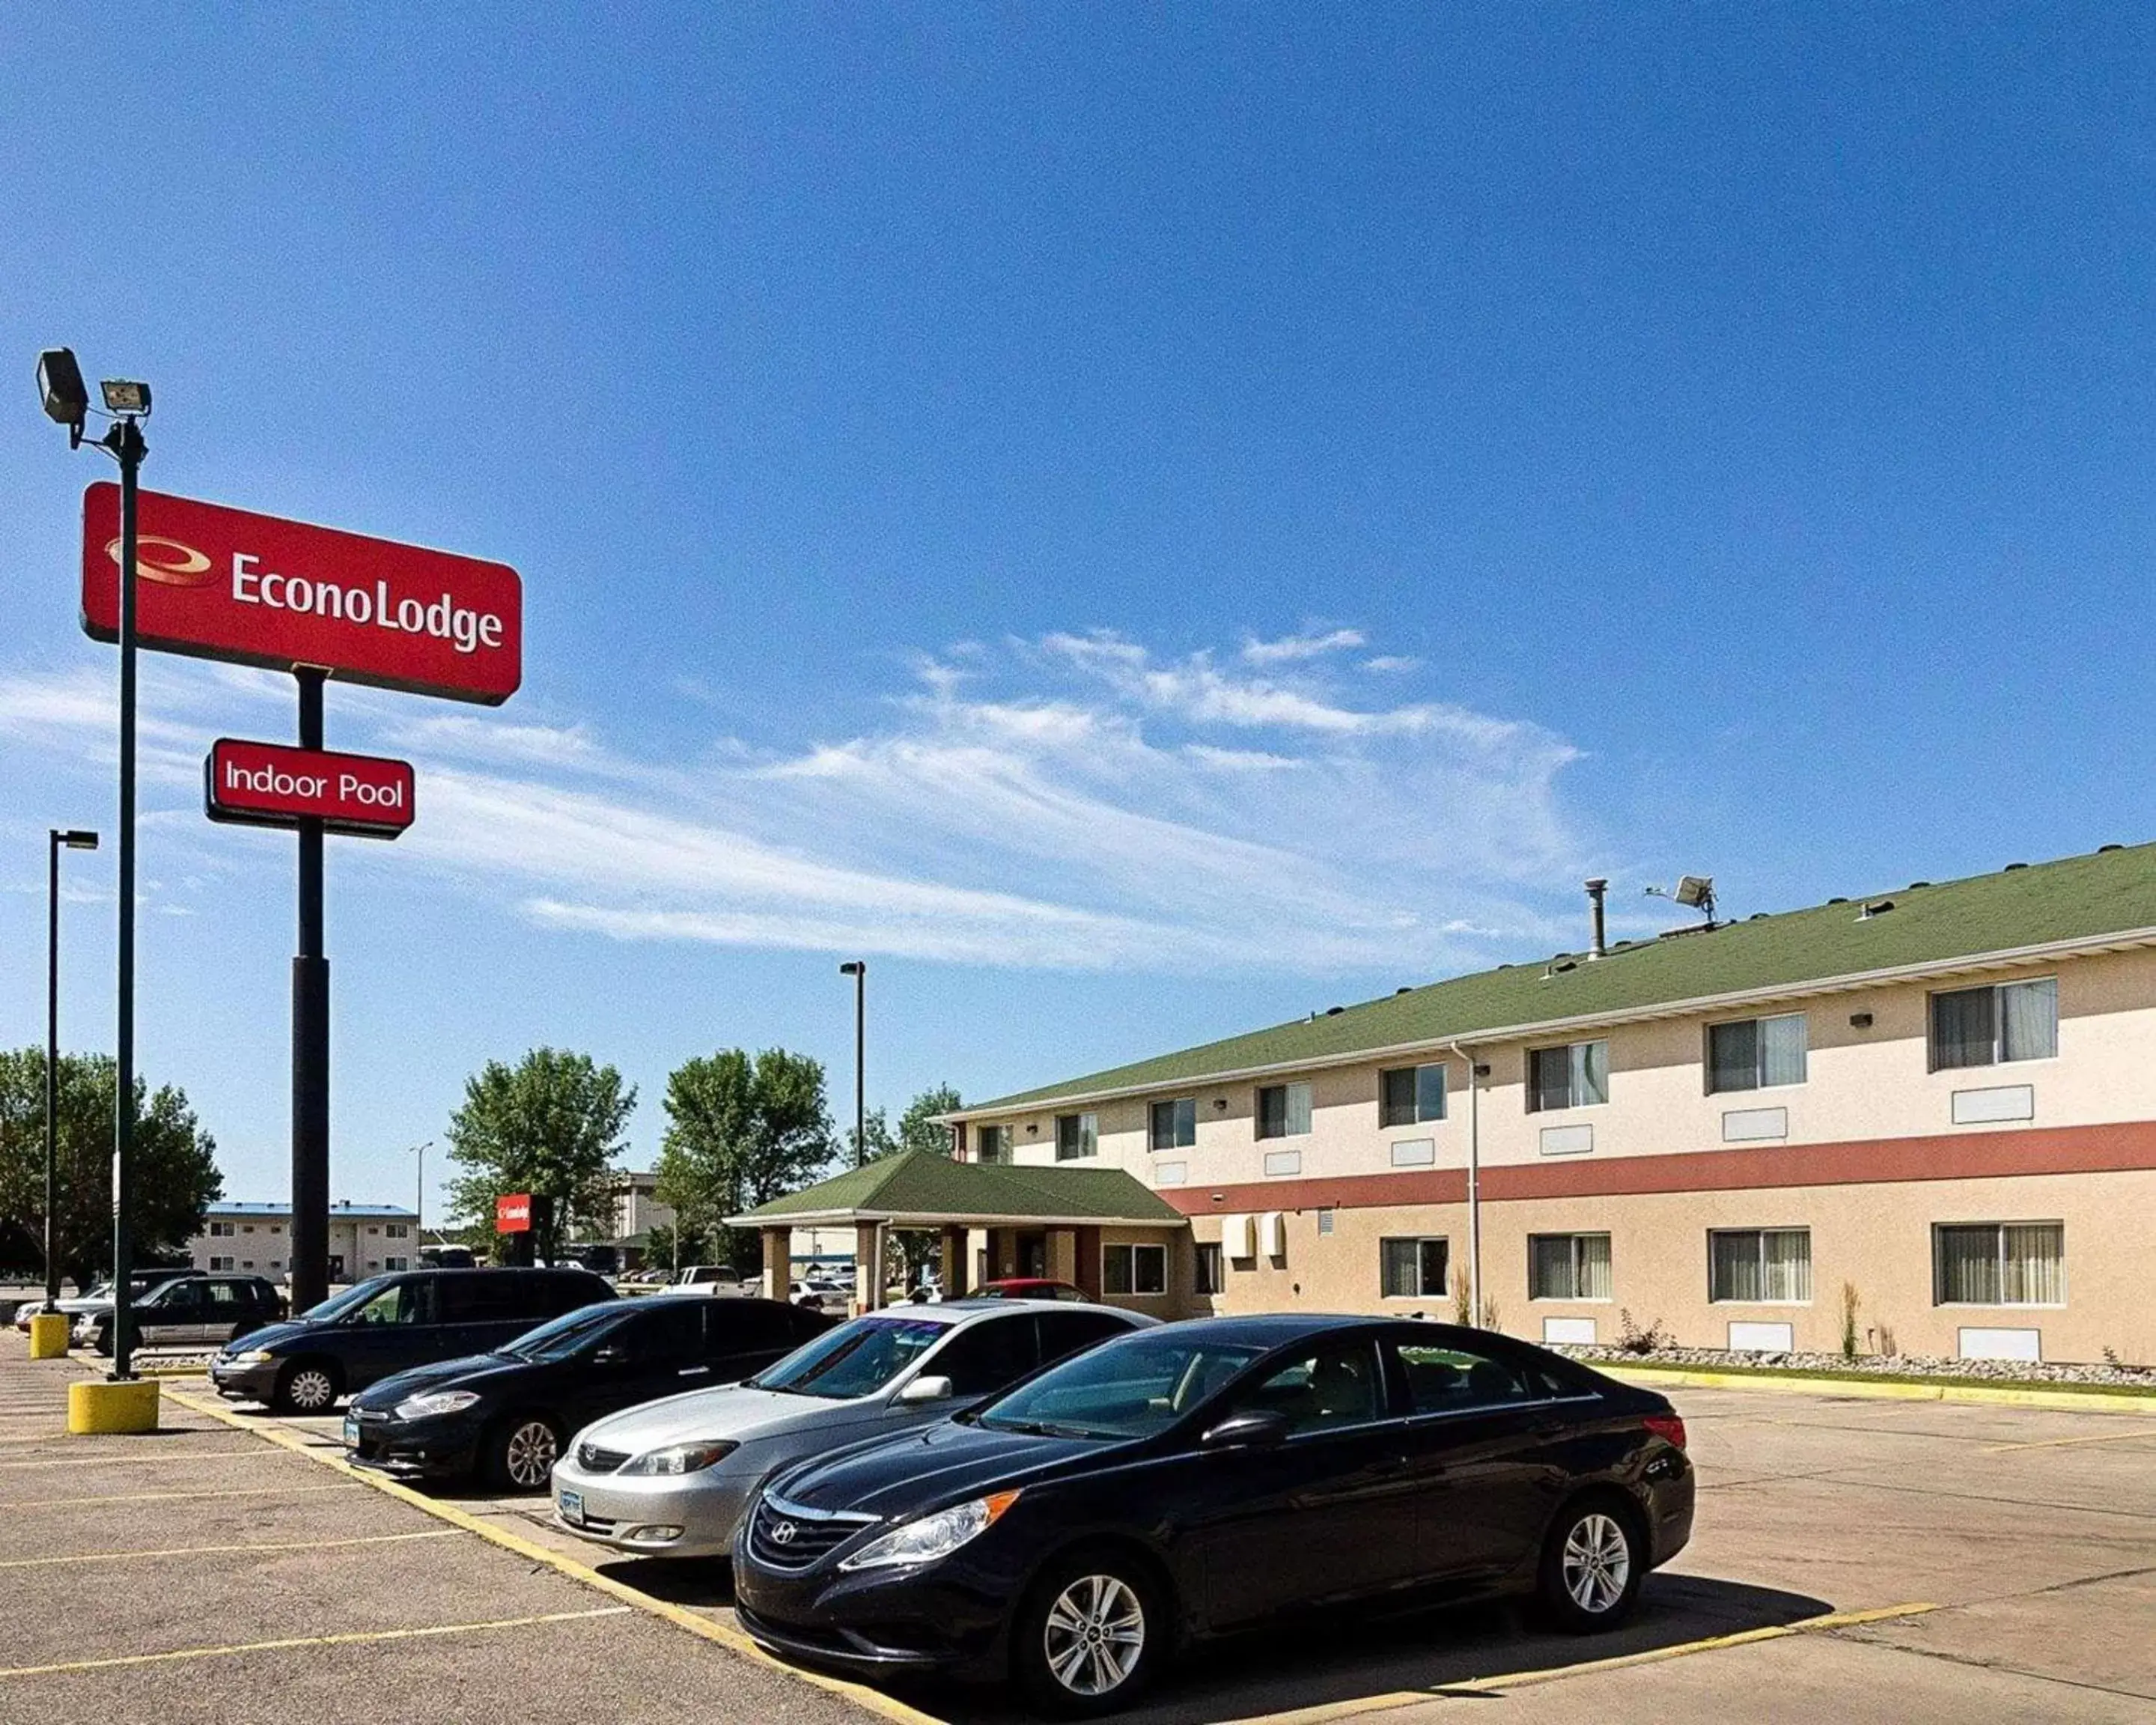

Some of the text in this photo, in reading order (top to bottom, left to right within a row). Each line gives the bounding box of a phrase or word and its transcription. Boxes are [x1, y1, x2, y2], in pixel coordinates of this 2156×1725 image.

[232, 552, 502, 653] EconoLodge
[226, 761, 403, 808] Indoor Pool
